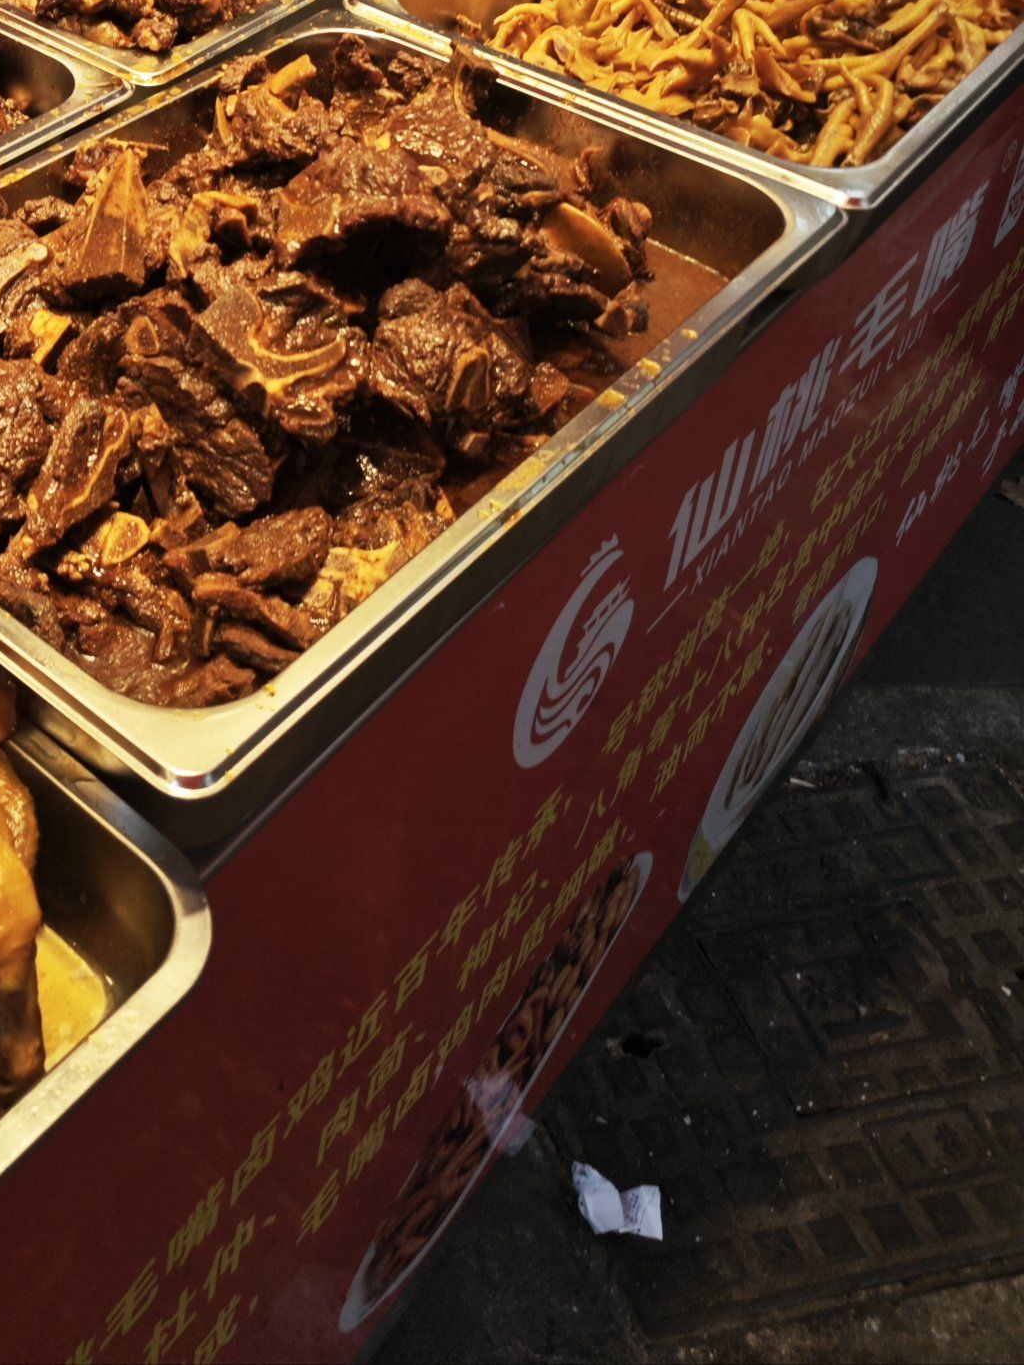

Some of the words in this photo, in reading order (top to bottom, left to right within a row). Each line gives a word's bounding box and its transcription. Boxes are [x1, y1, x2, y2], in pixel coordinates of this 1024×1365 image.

[664, 179, 990, 591] 仙桃毛嘴
[692, 458, 792, 594] XIANTAO
[797, 363, 880, 470] MAOZUI
[886, 312, 928, 372] LUJI
